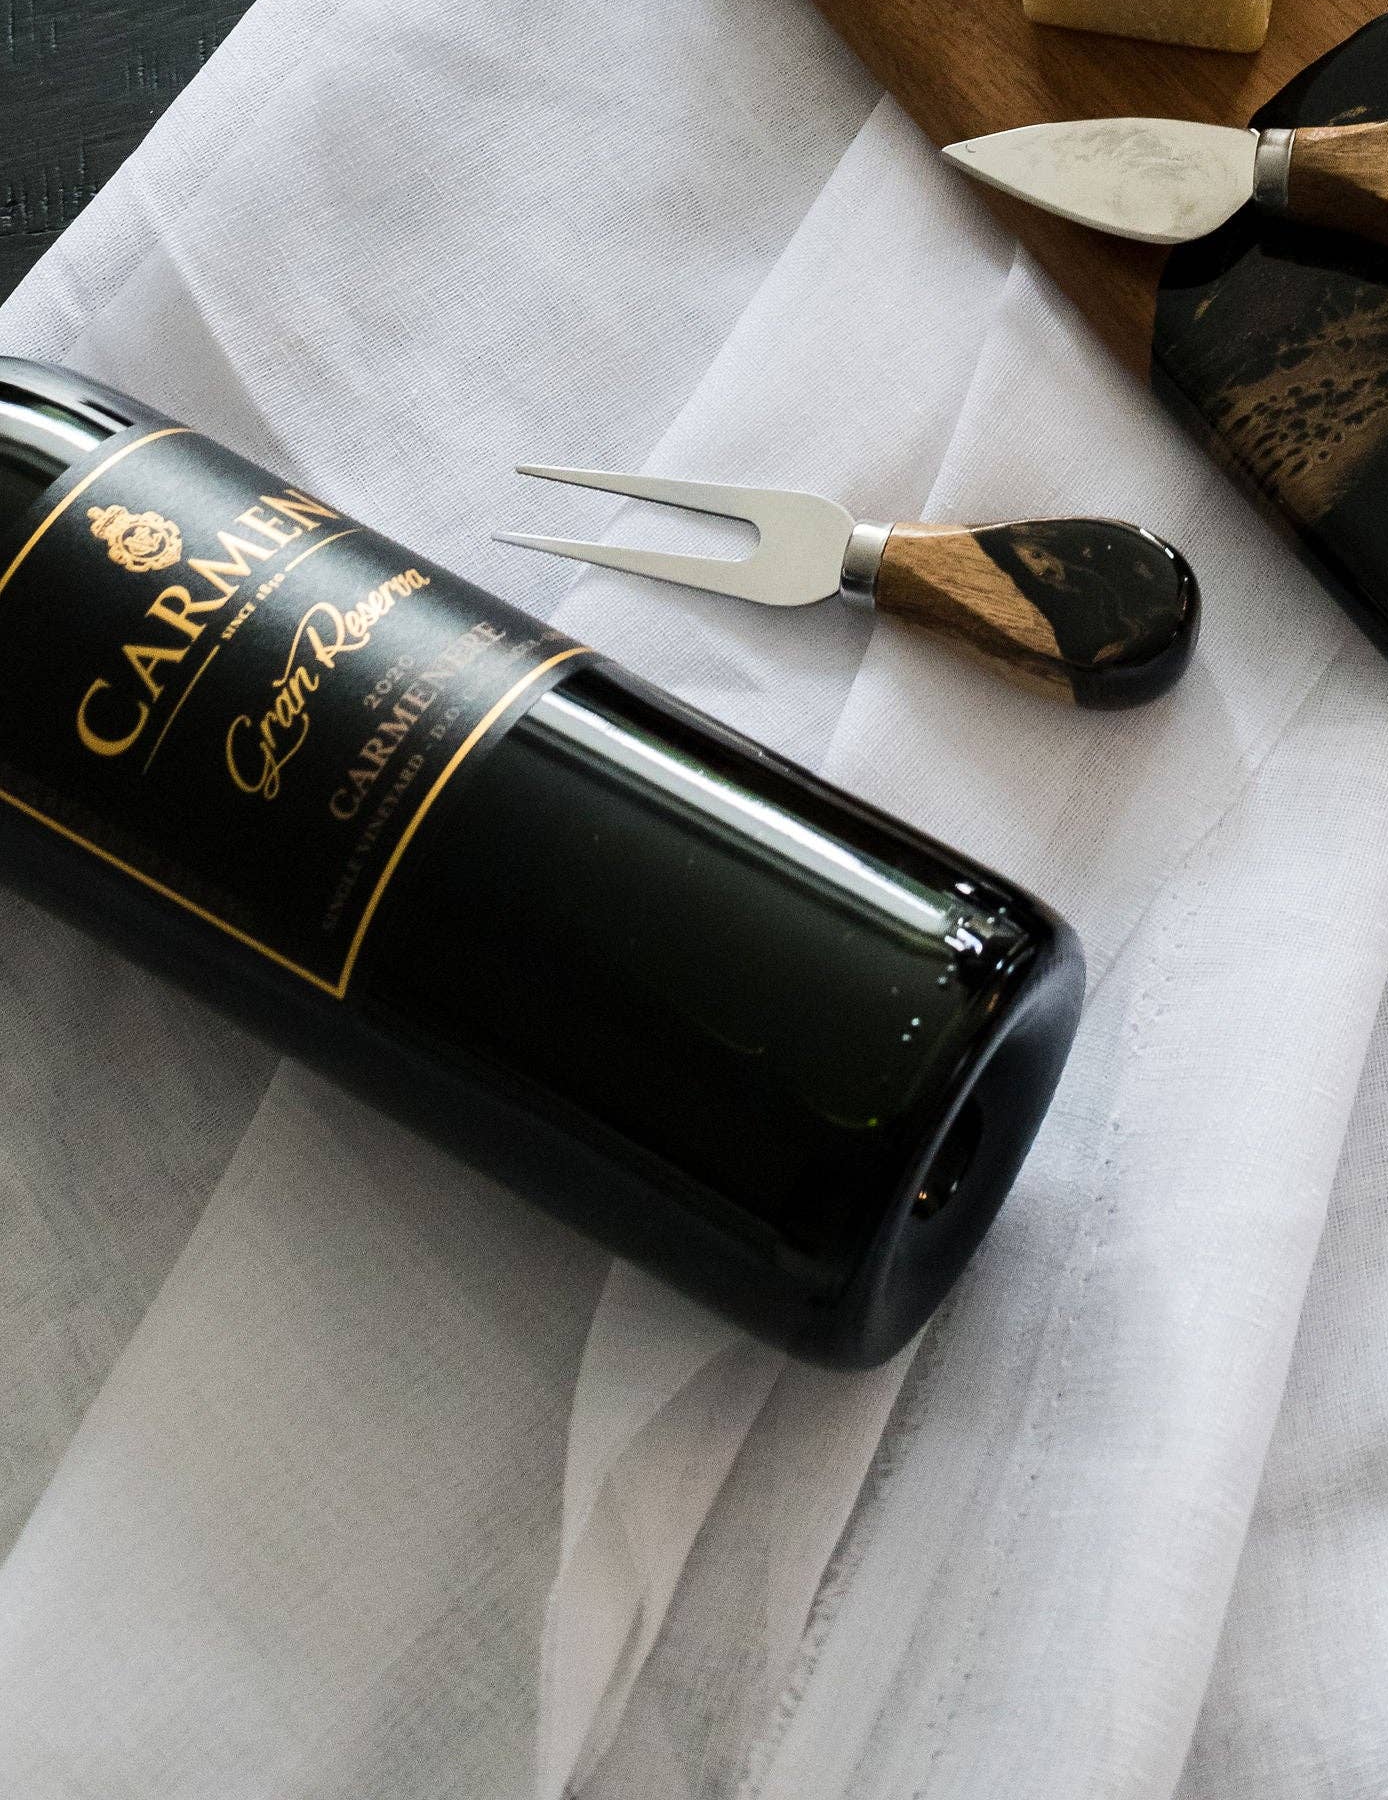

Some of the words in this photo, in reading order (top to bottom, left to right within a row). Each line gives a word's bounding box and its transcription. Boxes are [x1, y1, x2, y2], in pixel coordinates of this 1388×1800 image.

[77, 489, 341, 757] CARMEN
[221, 601, 257, 640] SINCE
[272, 568, 431, 687] Reserva
[226, 666, 319, 800] Gran
[363, 654, 414, 710] 2020
[356, 754, 425, 854] VINEYARD
